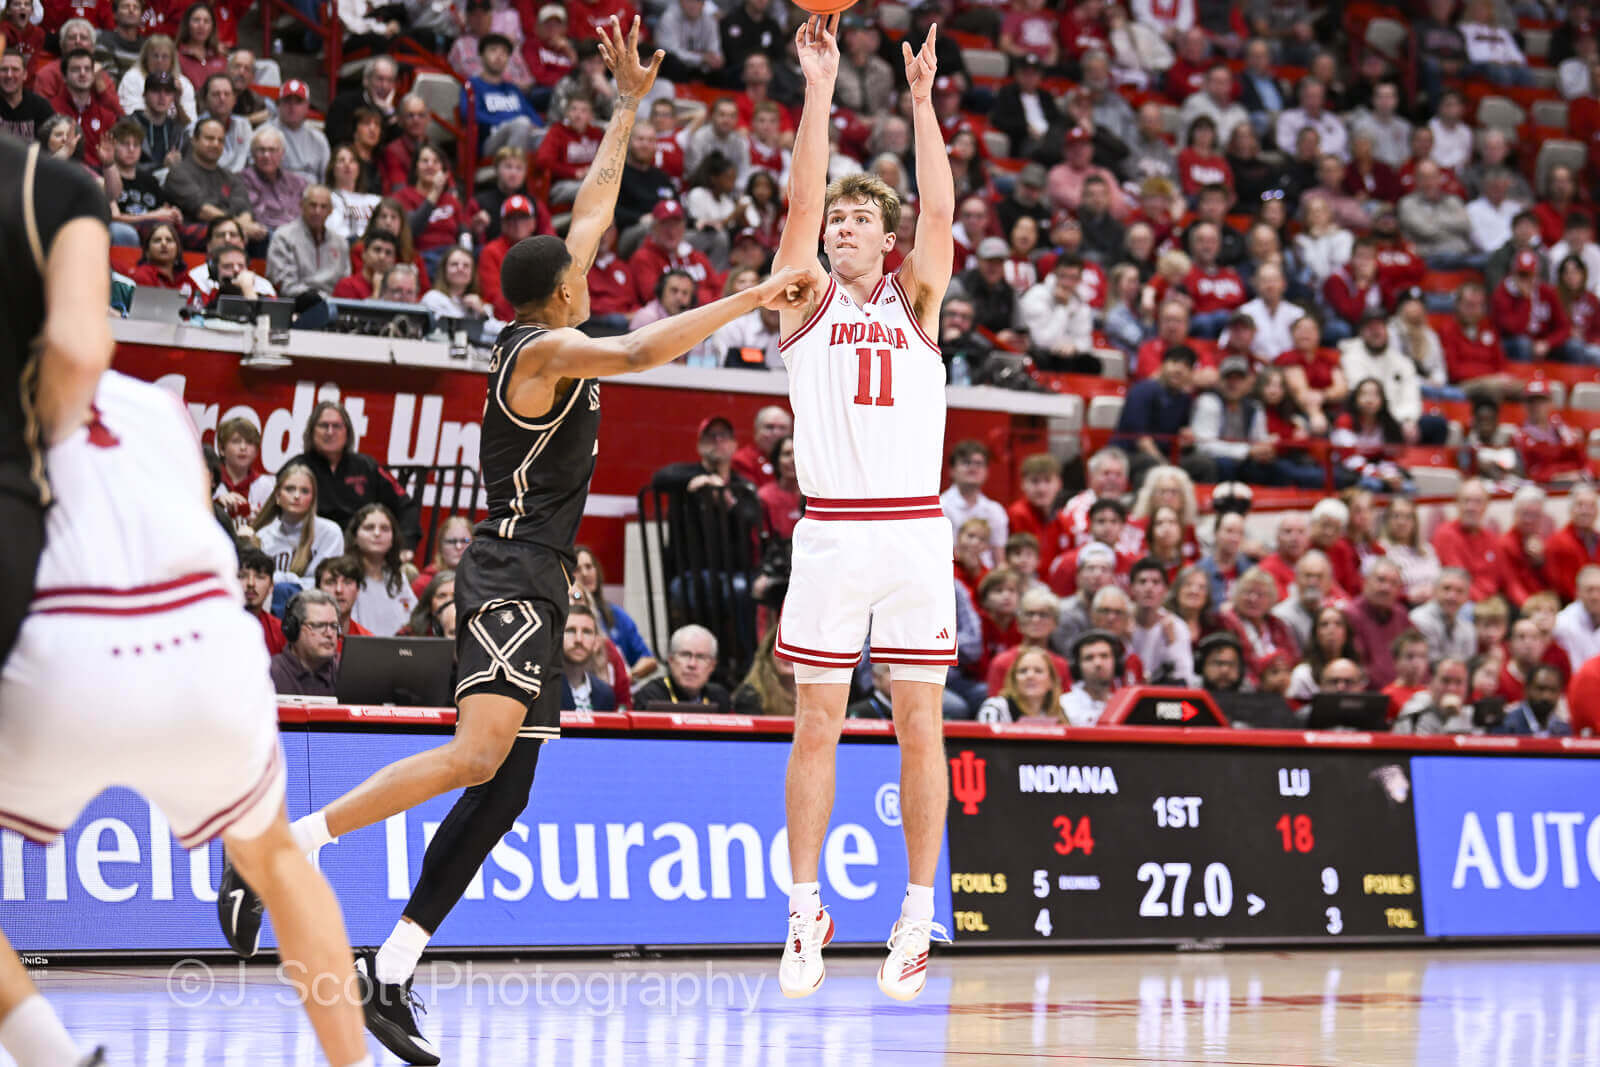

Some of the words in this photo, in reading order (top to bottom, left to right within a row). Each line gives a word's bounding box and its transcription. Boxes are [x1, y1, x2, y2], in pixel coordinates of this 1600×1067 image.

[829, 321, 909, 349] INDIANA
[854, 347, 894, 406] 11
[1019, 764, 1118, 794] INDIANA
[1279, 768, 1311, 797] LU
[1153, 796, 1203, 828] 1ST
[1052, 815, 1094, 855] 34
[1276, 814, 1315, 853] 18
[385, 811, 878, 901] Isurane
[951, 873, 1007, 893] FOULS
[1033, 869, 1050, 898] 5
[1137, 862, 1233, 917] 27.0
[1321, 867, 1339, 895] 9
[1363, 874, 1415, 894] FOULS
[953, 911, 989, 931] TOL
[1034, 908, 1052, 936] 4
[1325, 907, 1343, 934] 3
